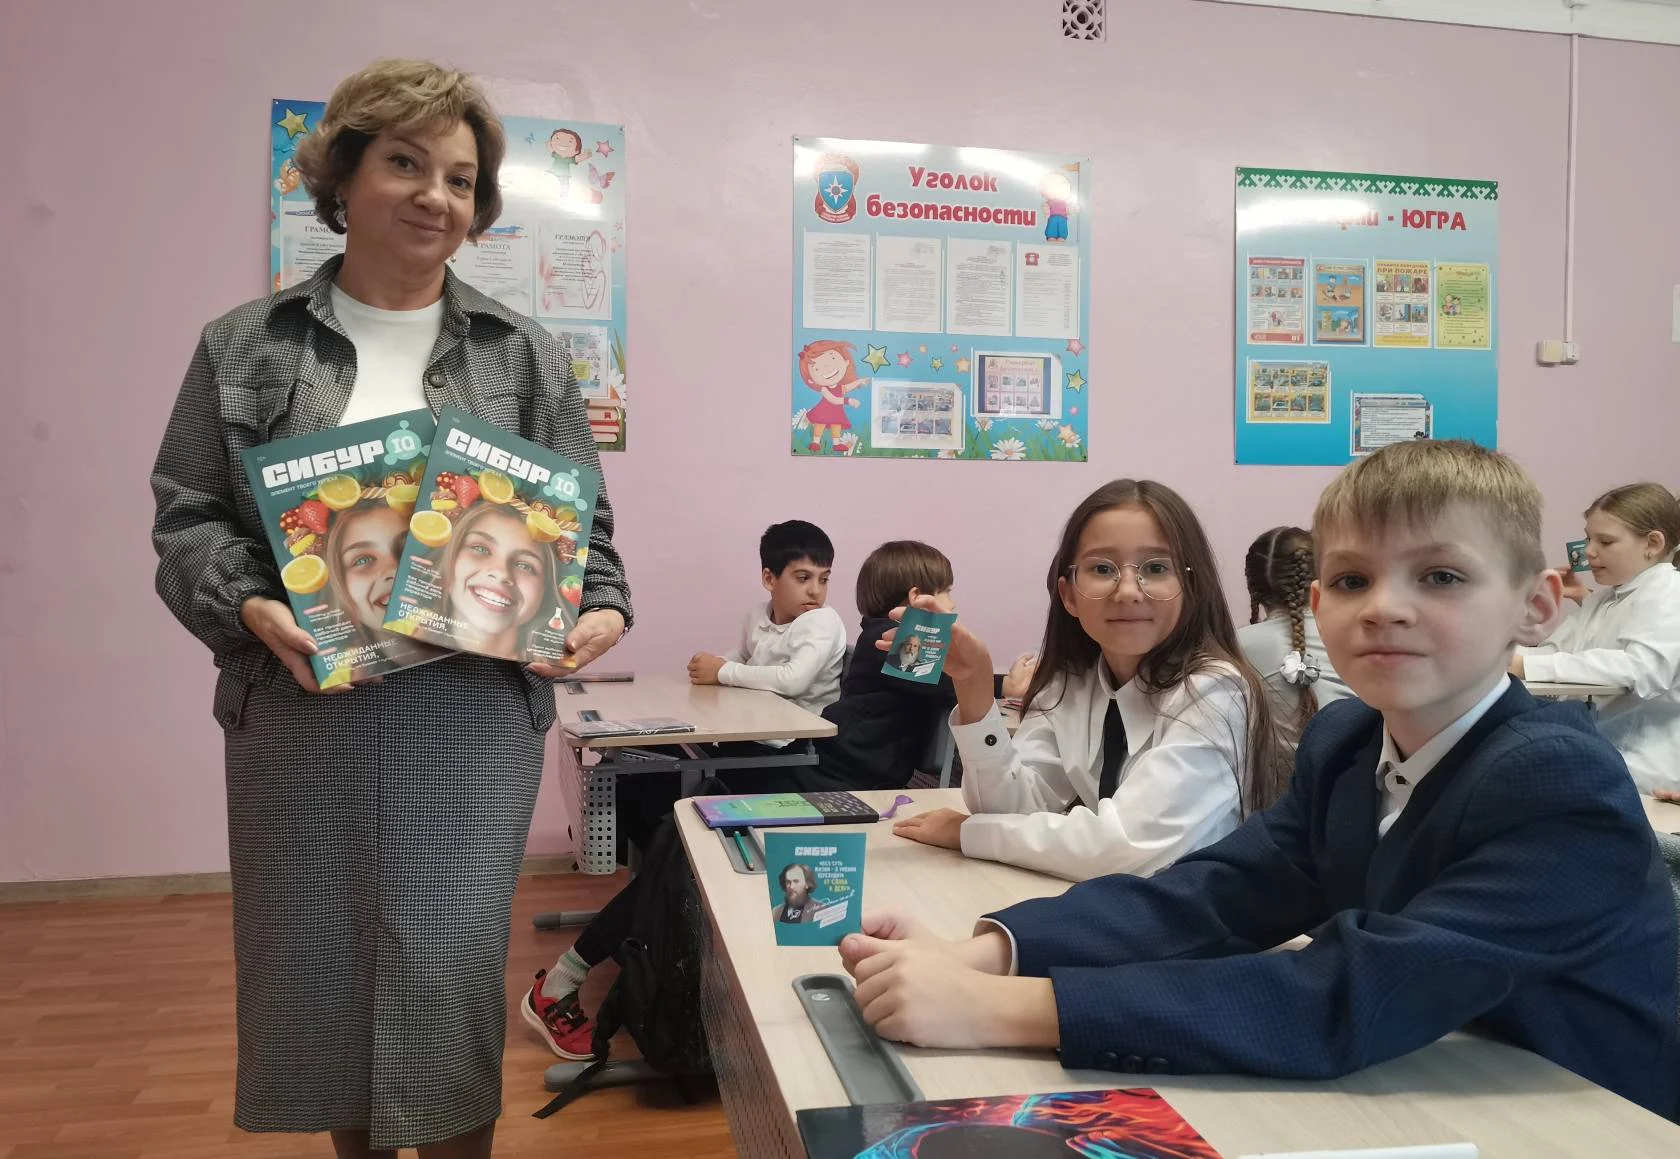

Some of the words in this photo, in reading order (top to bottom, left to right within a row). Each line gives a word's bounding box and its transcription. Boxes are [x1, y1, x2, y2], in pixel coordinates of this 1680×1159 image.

[909, 166, 998, 192] Уголок
[866, 195, 1036, 226] безопасности
[1402, 209, 1466, 230] ЮГРА
[262, 439, 384, 488] СИБУР
[390, 435, 416, 453] IQ
[446, 428, 551, 484] СИБУР
[555, 477, 575, 496] IQ
[795, 846, 837, 856] СИБУР
